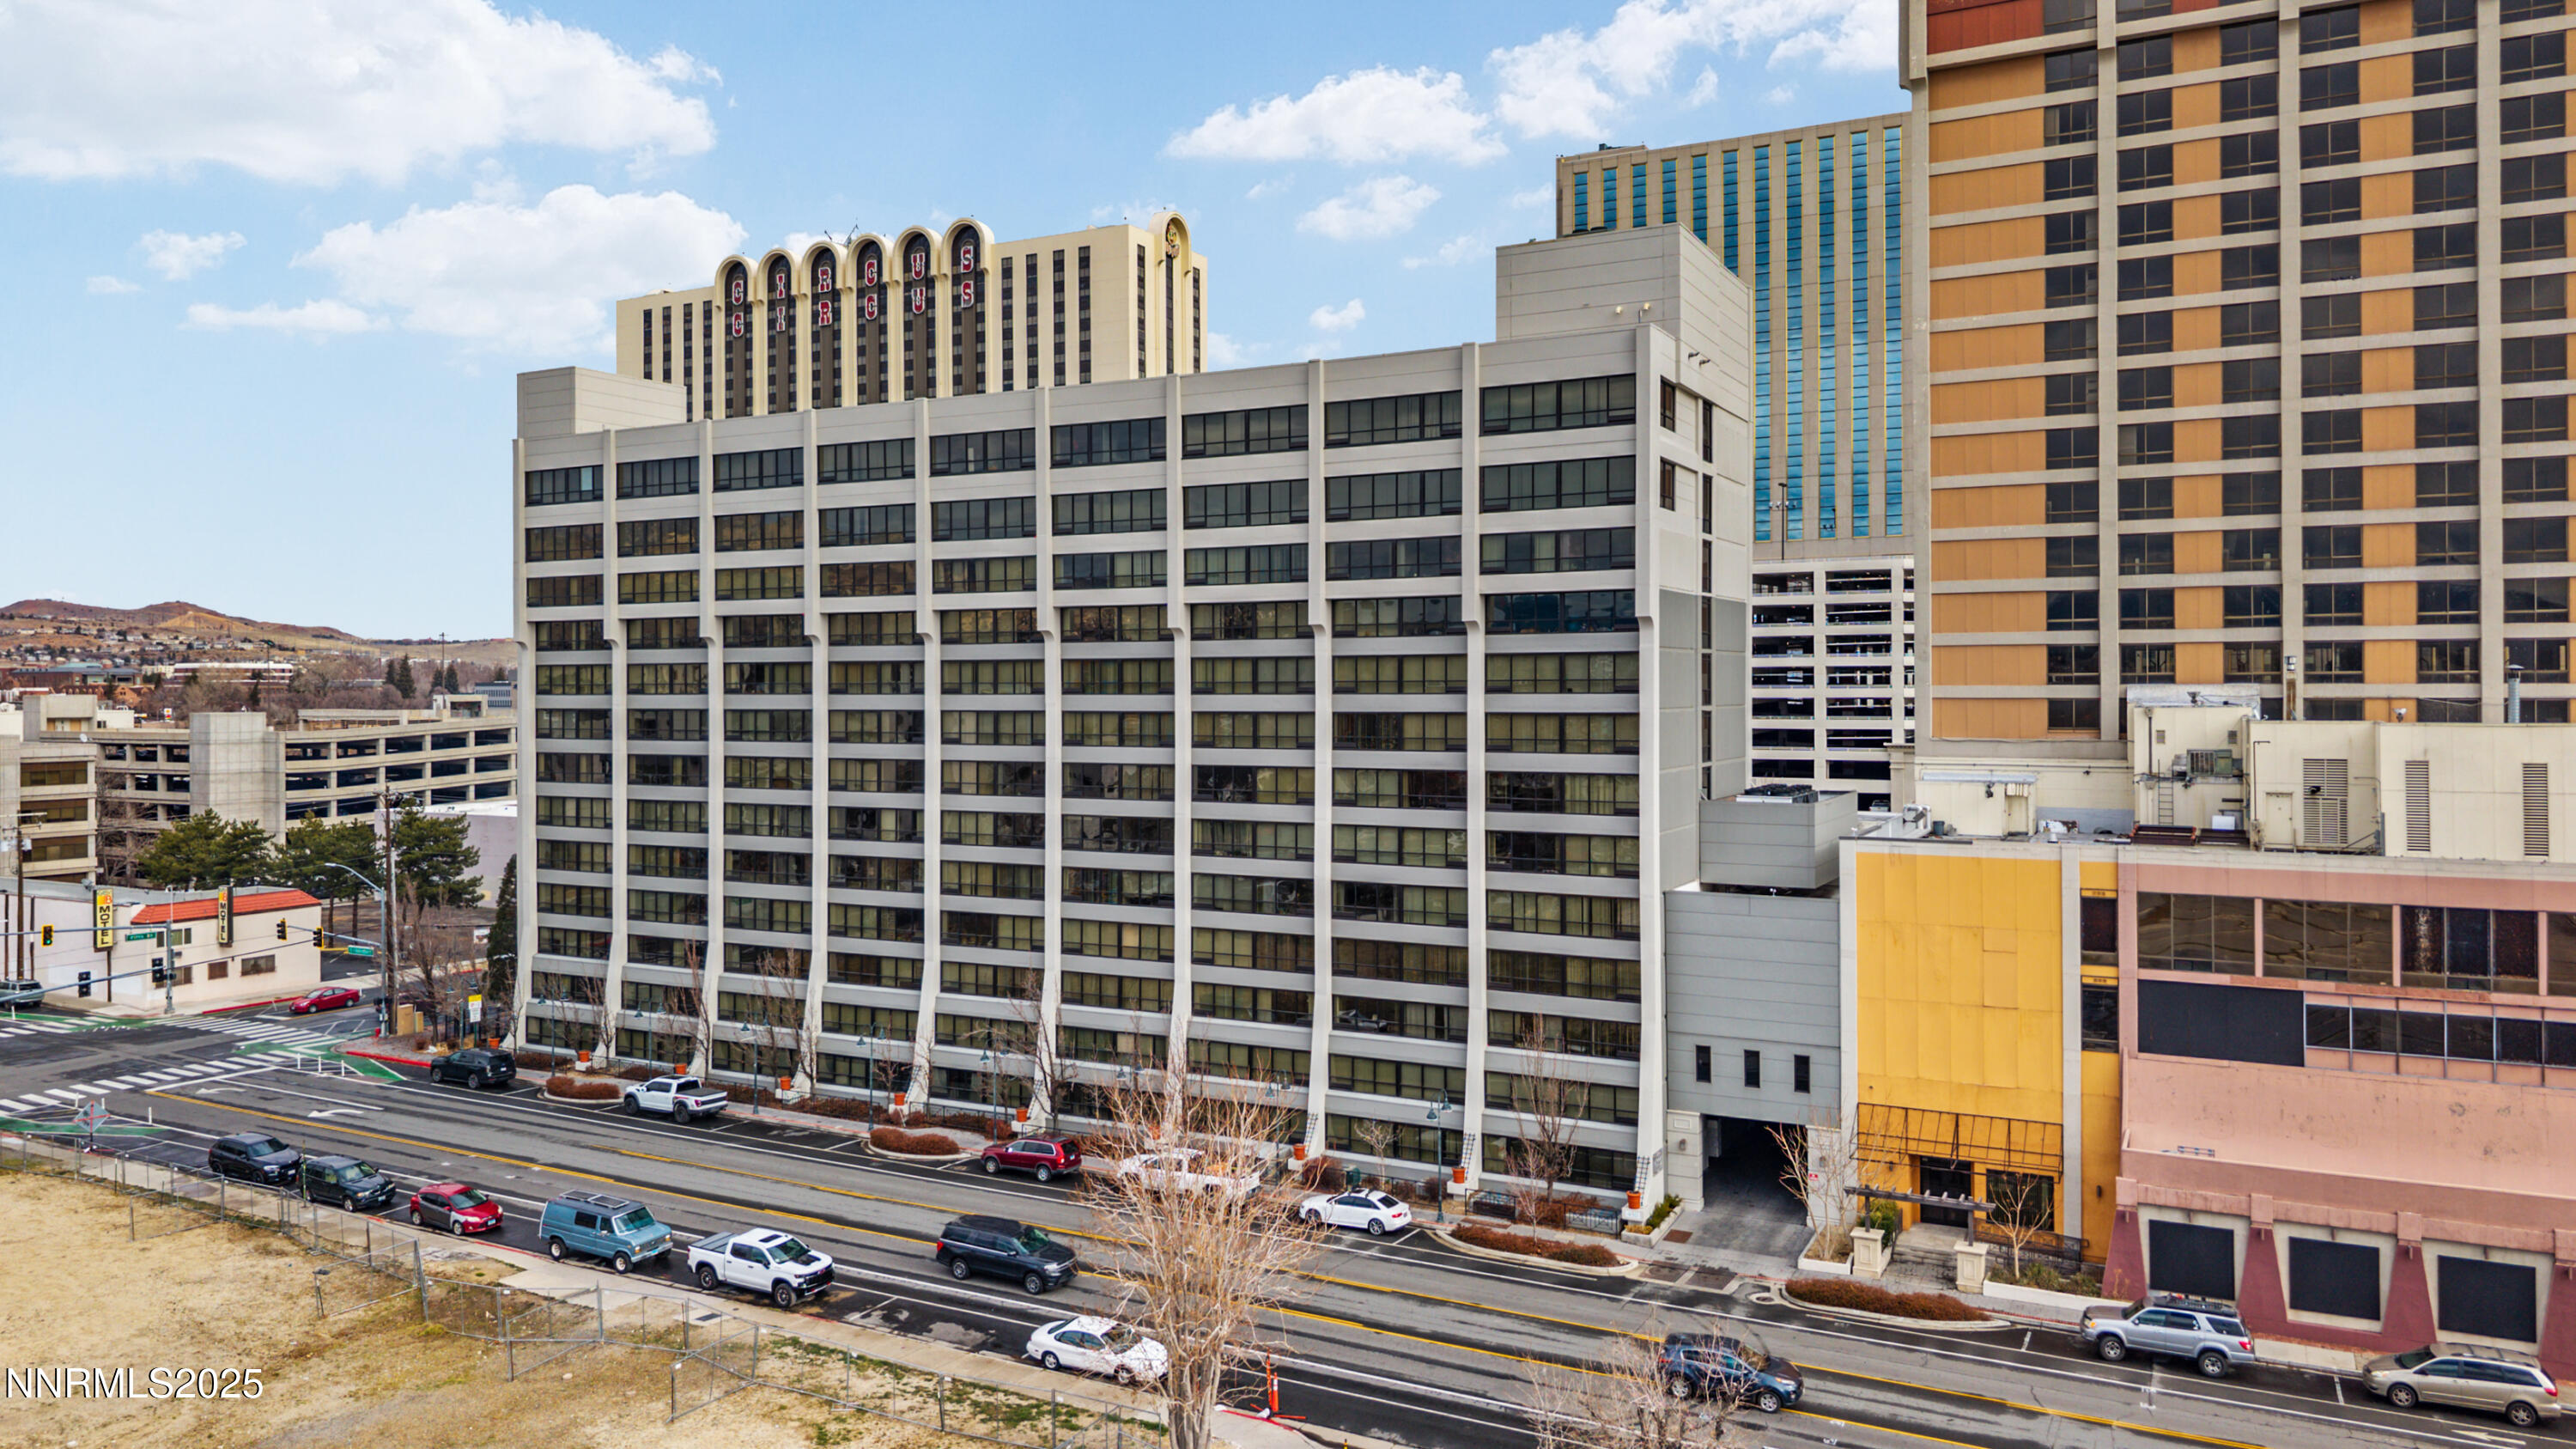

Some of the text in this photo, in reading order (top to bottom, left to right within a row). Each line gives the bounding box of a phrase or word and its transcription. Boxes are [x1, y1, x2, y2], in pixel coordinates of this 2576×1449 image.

[732, 246, 974, 305] CIRCUS
[732, 280, 974, 338] CIRCUS
[99, 905, 111, 945] MOTEL
